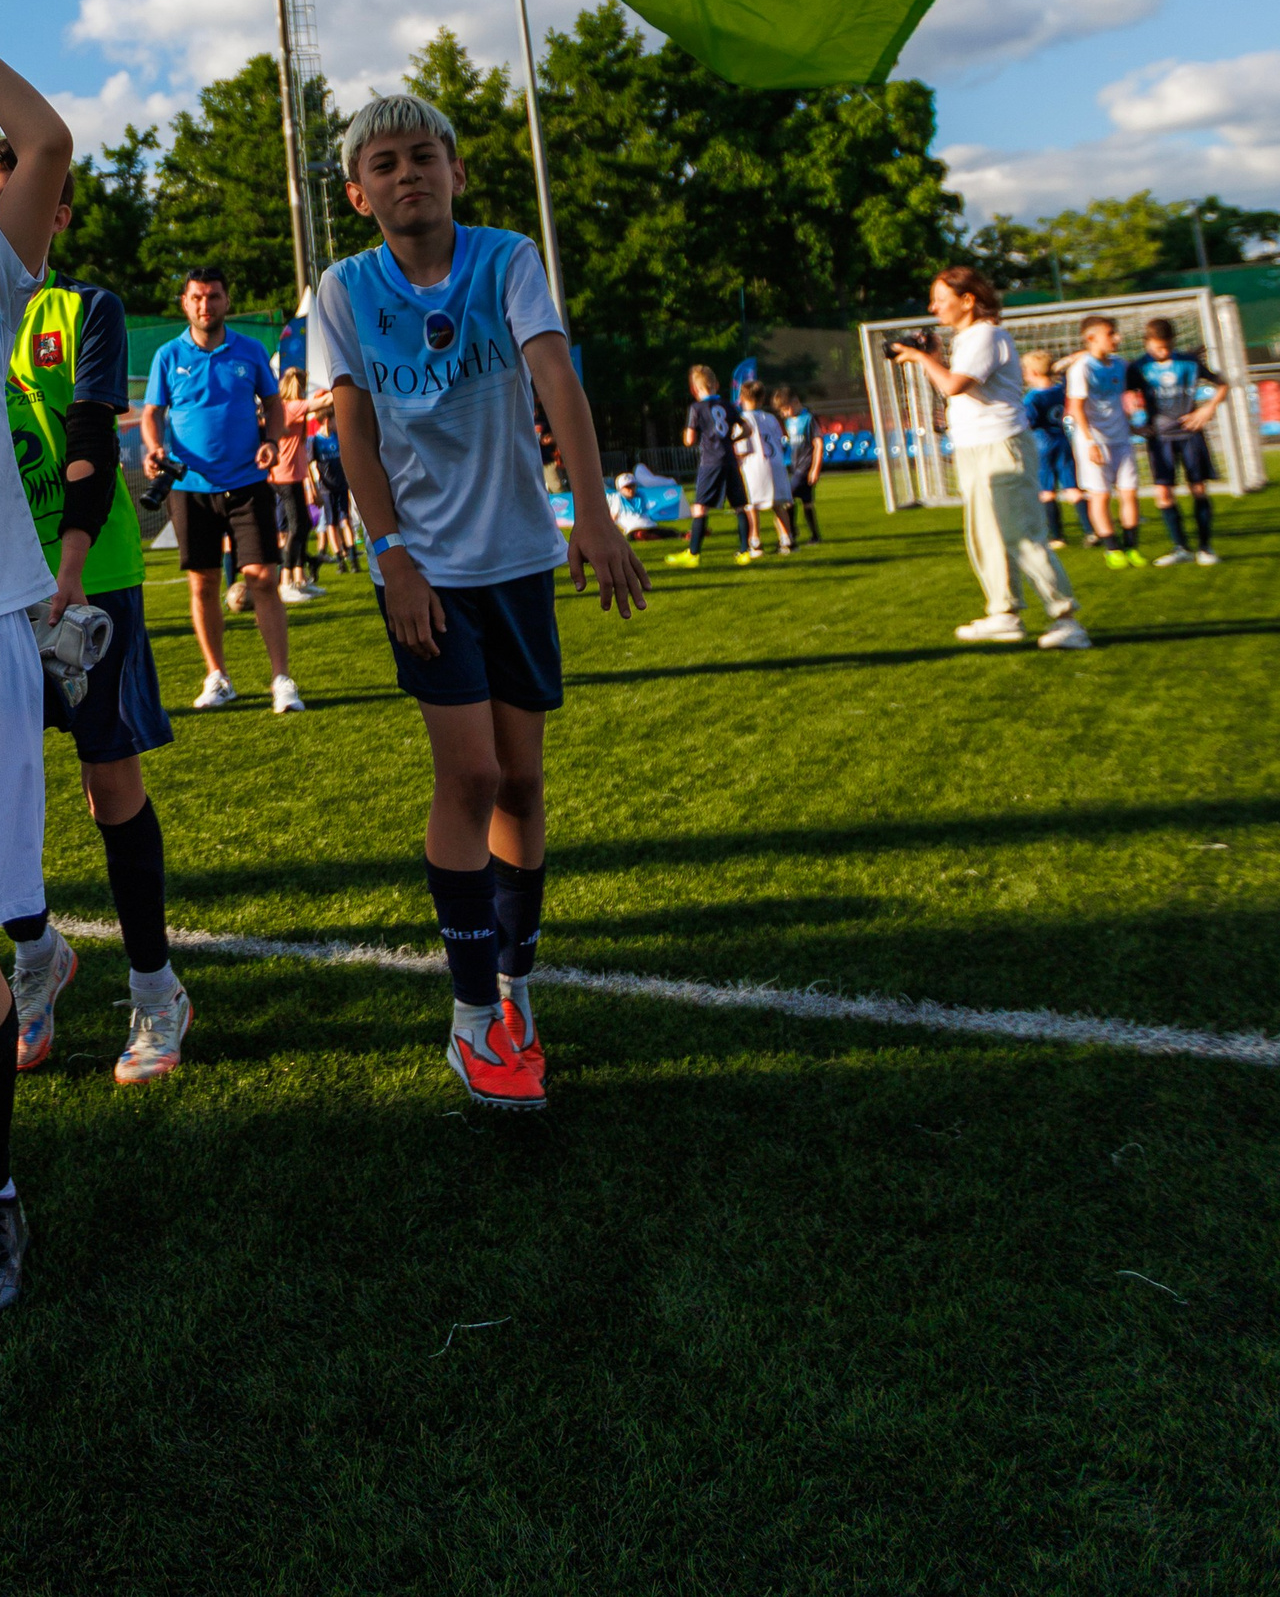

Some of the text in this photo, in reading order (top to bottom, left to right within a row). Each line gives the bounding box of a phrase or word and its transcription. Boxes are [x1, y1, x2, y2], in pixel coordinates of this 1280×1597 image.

[371, 338, 507, 395] РОДИНА
[17, 390, 46, 406] 2109
[711, 405, 729, 437] 8
